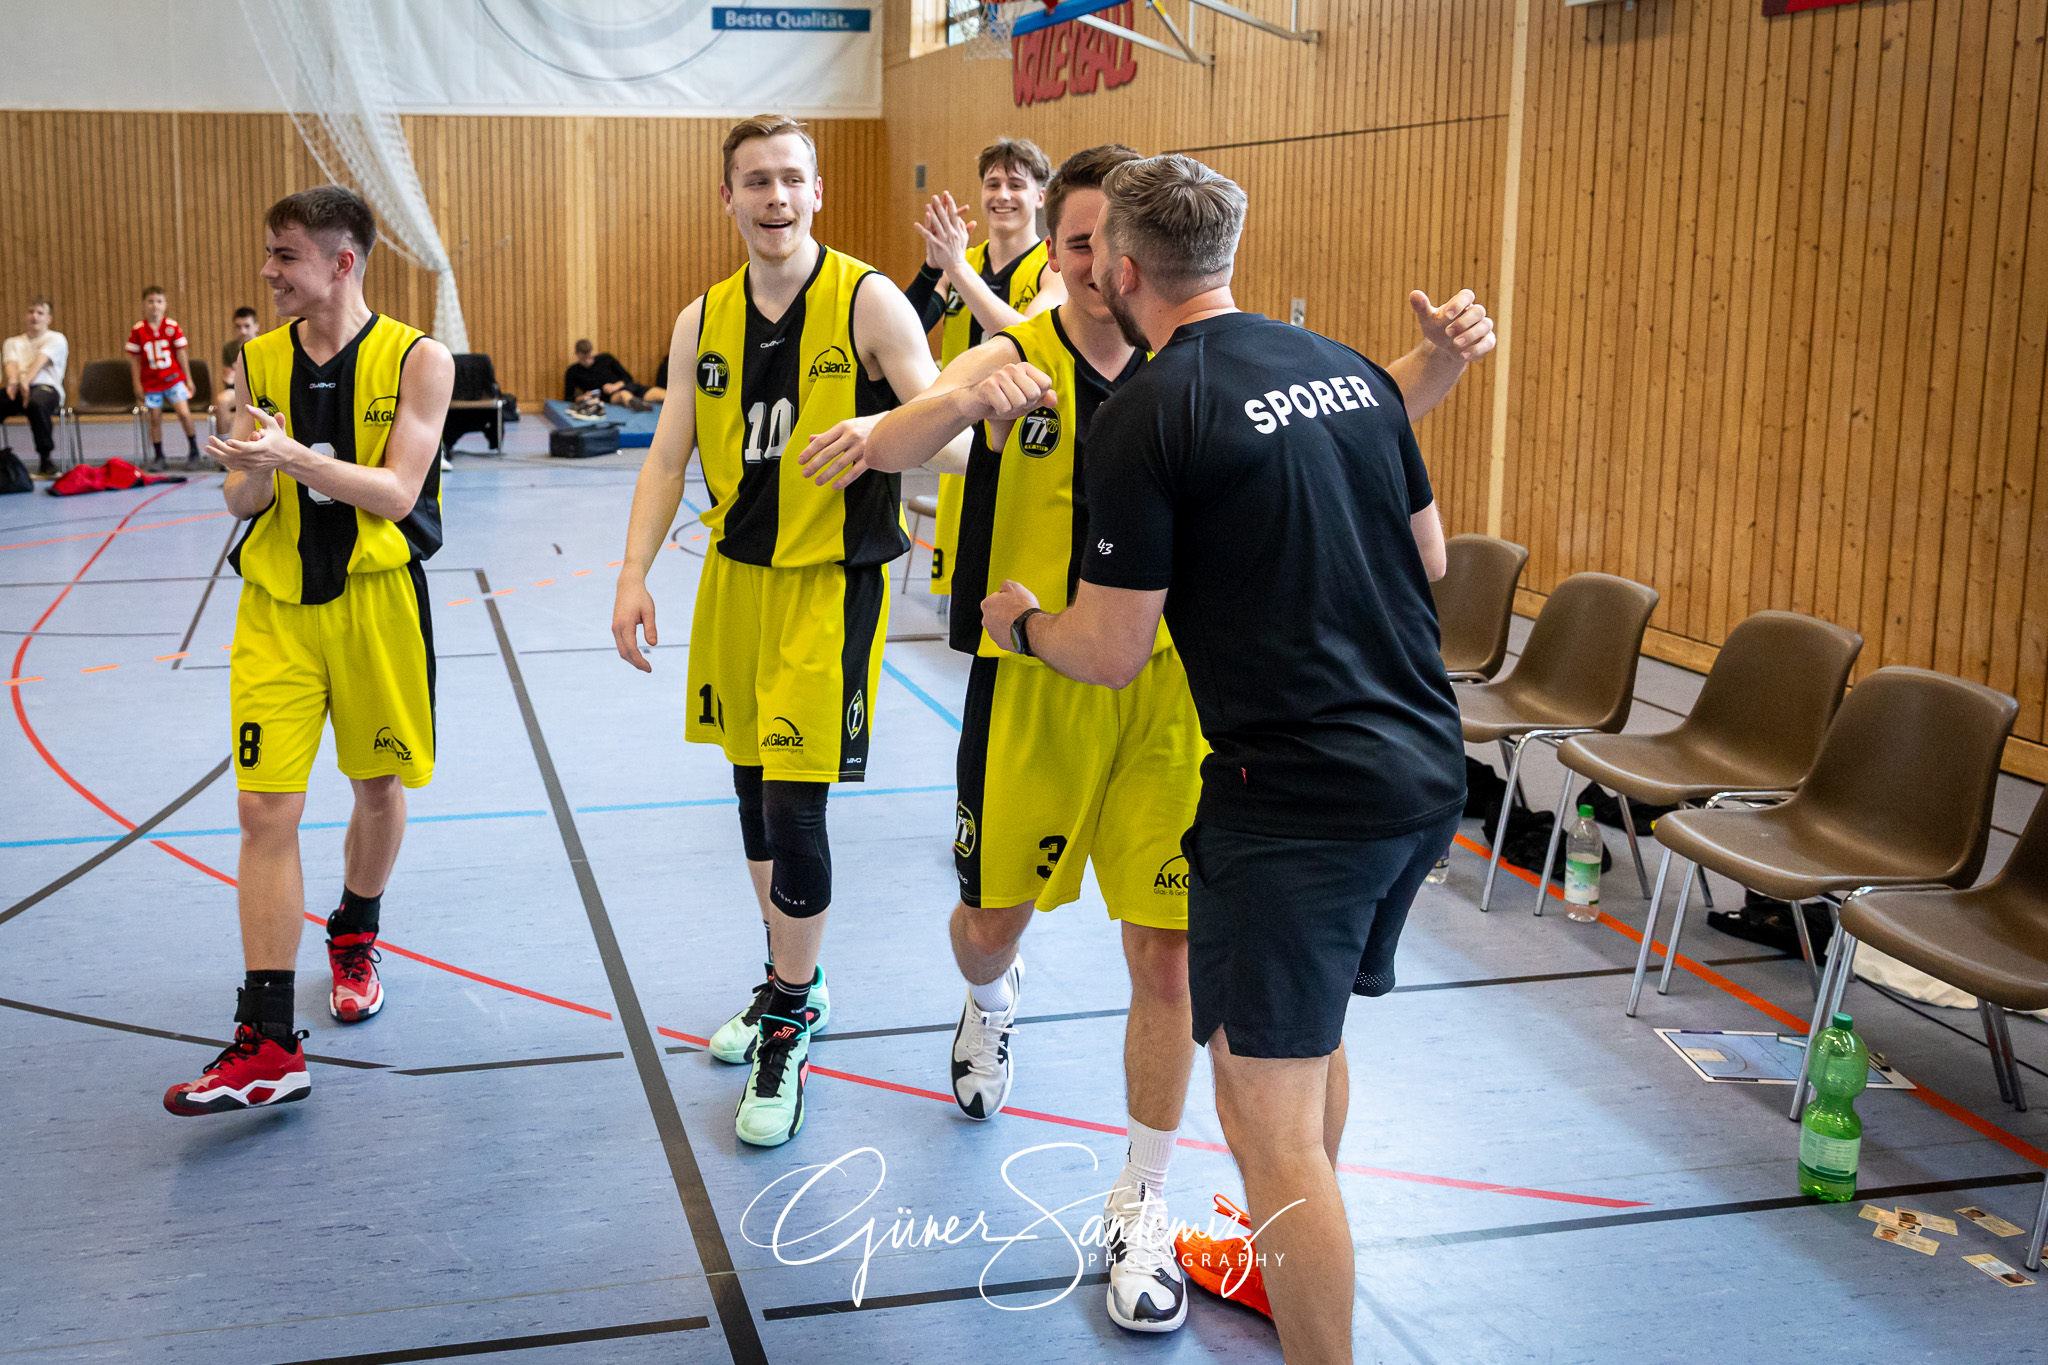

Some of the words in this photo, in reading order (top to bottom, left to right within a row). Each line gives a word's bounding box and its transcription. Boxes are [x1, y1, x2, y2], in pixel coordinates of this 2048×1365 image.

[725, 10, 773, 27] Beste
[776, 11, 849, 29] Qualität.
[143, 339, 172, 370] 15
[1244, 375, 1380, 434] SPORER
[745, 398, 795, 463] 10
[1097, 538, 1114, 555] 43
[239, 722, 264, 770] 8
[1036, 835, 1067, 881] 3
